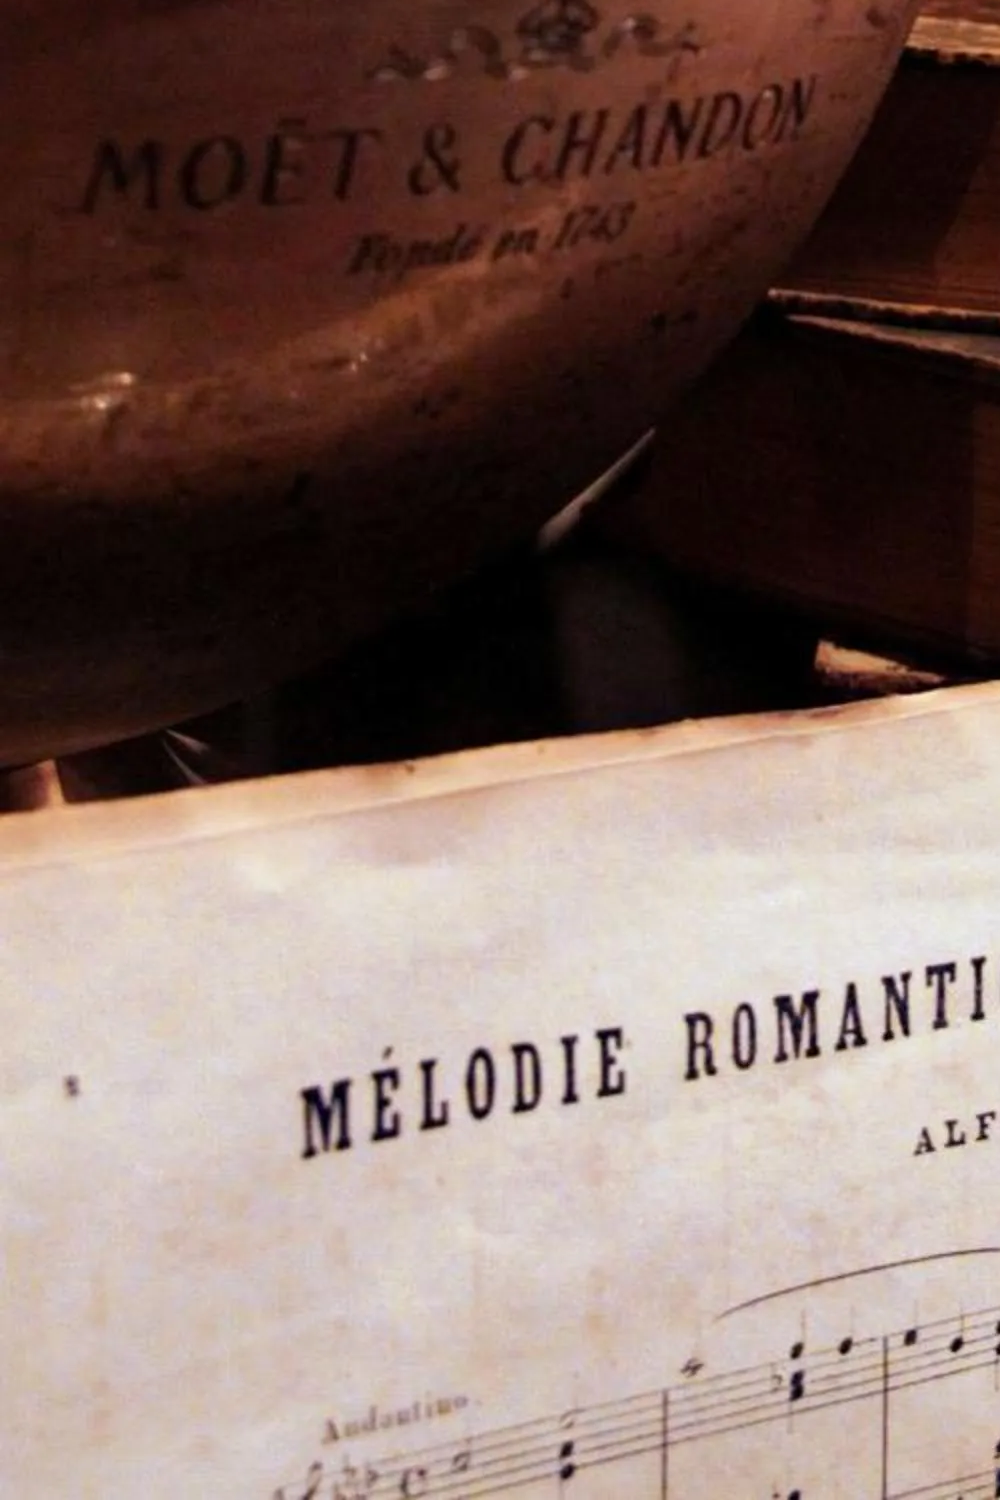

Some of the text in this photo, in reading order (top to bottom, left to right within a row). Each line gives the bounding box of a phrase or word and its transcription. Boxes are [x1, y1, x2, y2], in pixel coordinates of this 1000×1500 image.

[80, 73, 818, 216] MOËT & CHANDON
[490, 228, 540, 262] en
[551, 199, 637, 250] 1743
[299, 1026, 632, 1160] MÉLODIE
